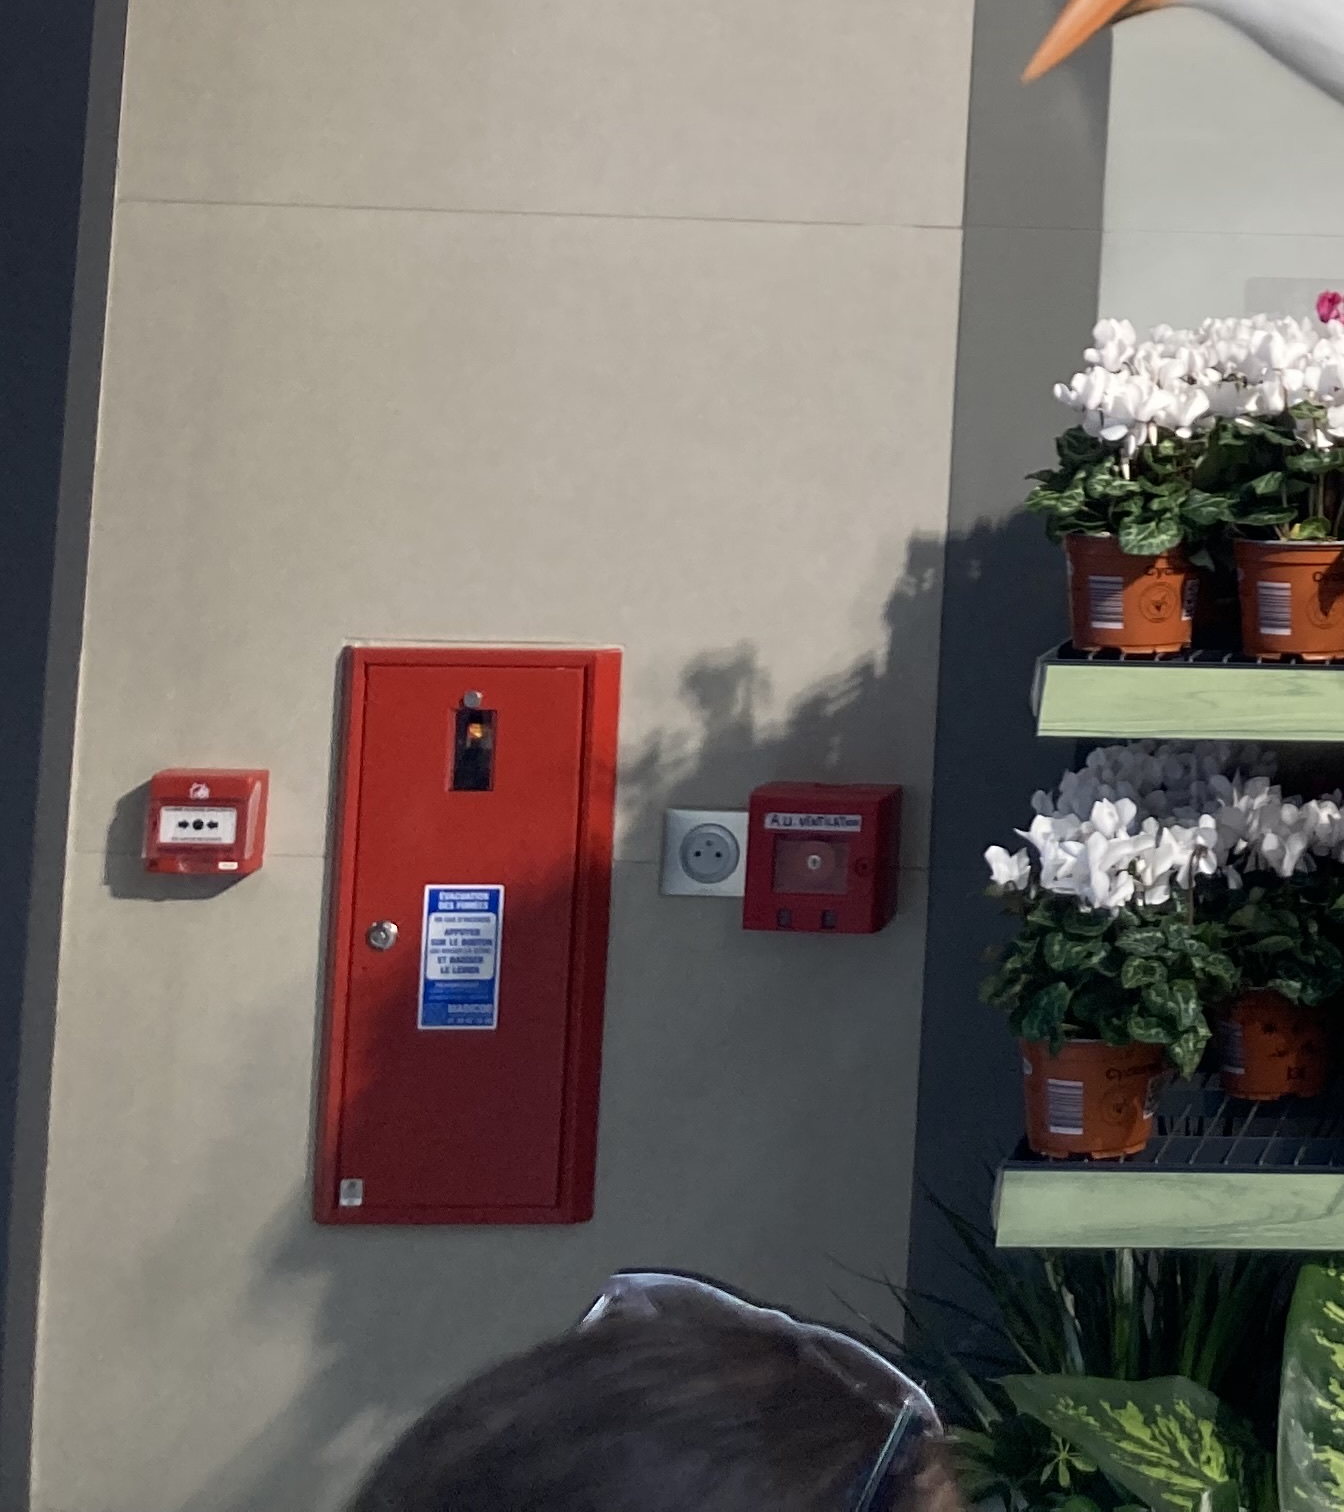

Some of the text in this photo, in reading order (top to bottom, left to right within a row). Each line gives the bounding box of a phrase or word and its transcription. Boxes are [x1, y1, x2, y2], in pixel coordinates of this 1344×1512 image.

[449, 938, 458, 946] LE
[437, 956, 447, 964] ET
[440, 966, 449, 974] LE
